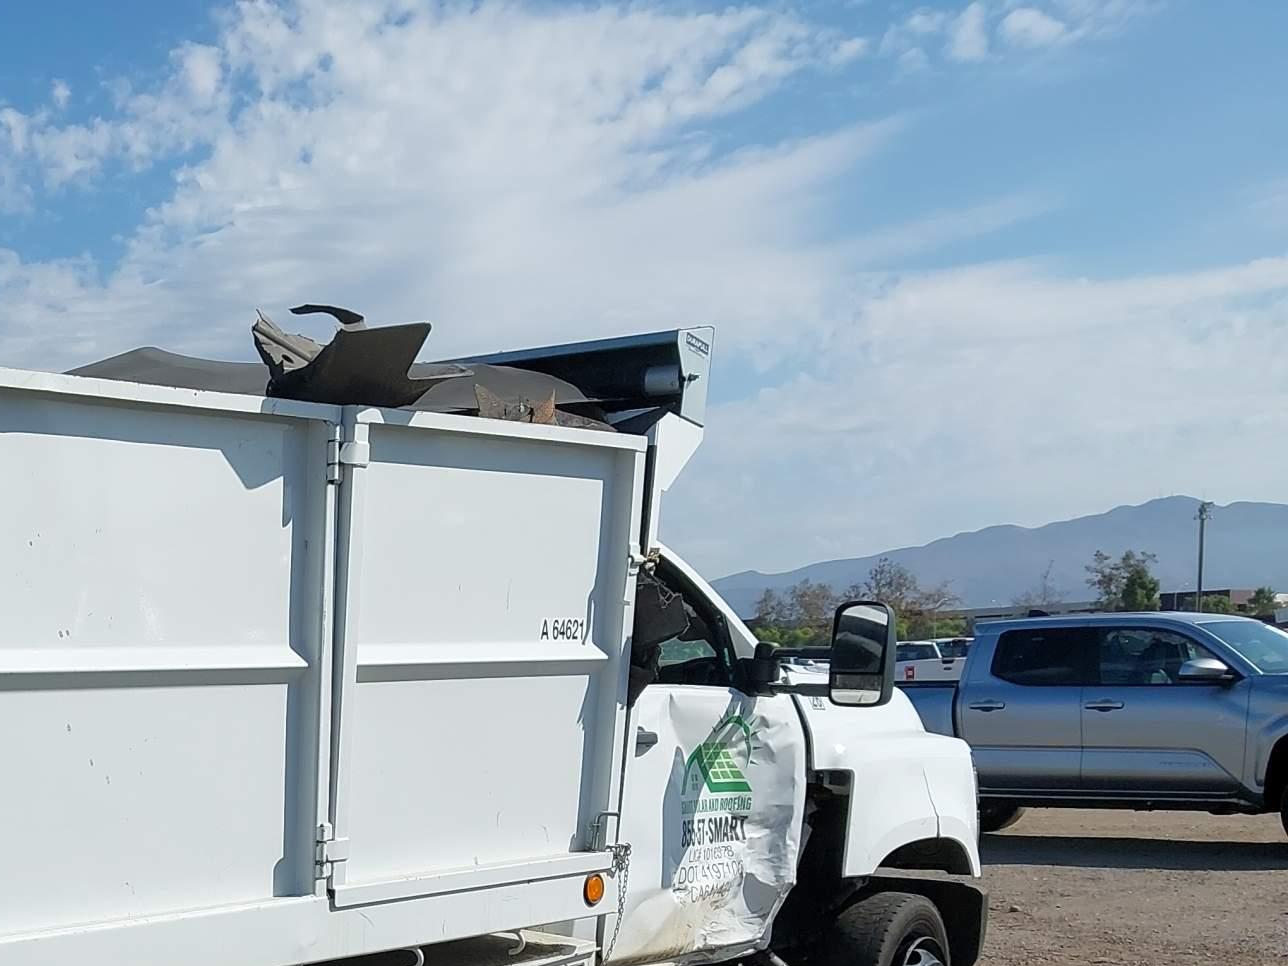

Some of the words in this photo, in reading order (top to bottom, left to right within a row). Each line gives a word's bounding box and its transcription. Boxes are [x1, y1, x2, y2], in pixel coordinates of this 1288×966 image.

[540, 618, 549, 640] A
[552, 619, 584, 640] 64621
[720, 796, 752, 811] ROOFING
[681, 815, 749, 849] 855-57-SMART
[678, 865, 698, 884] DOT
